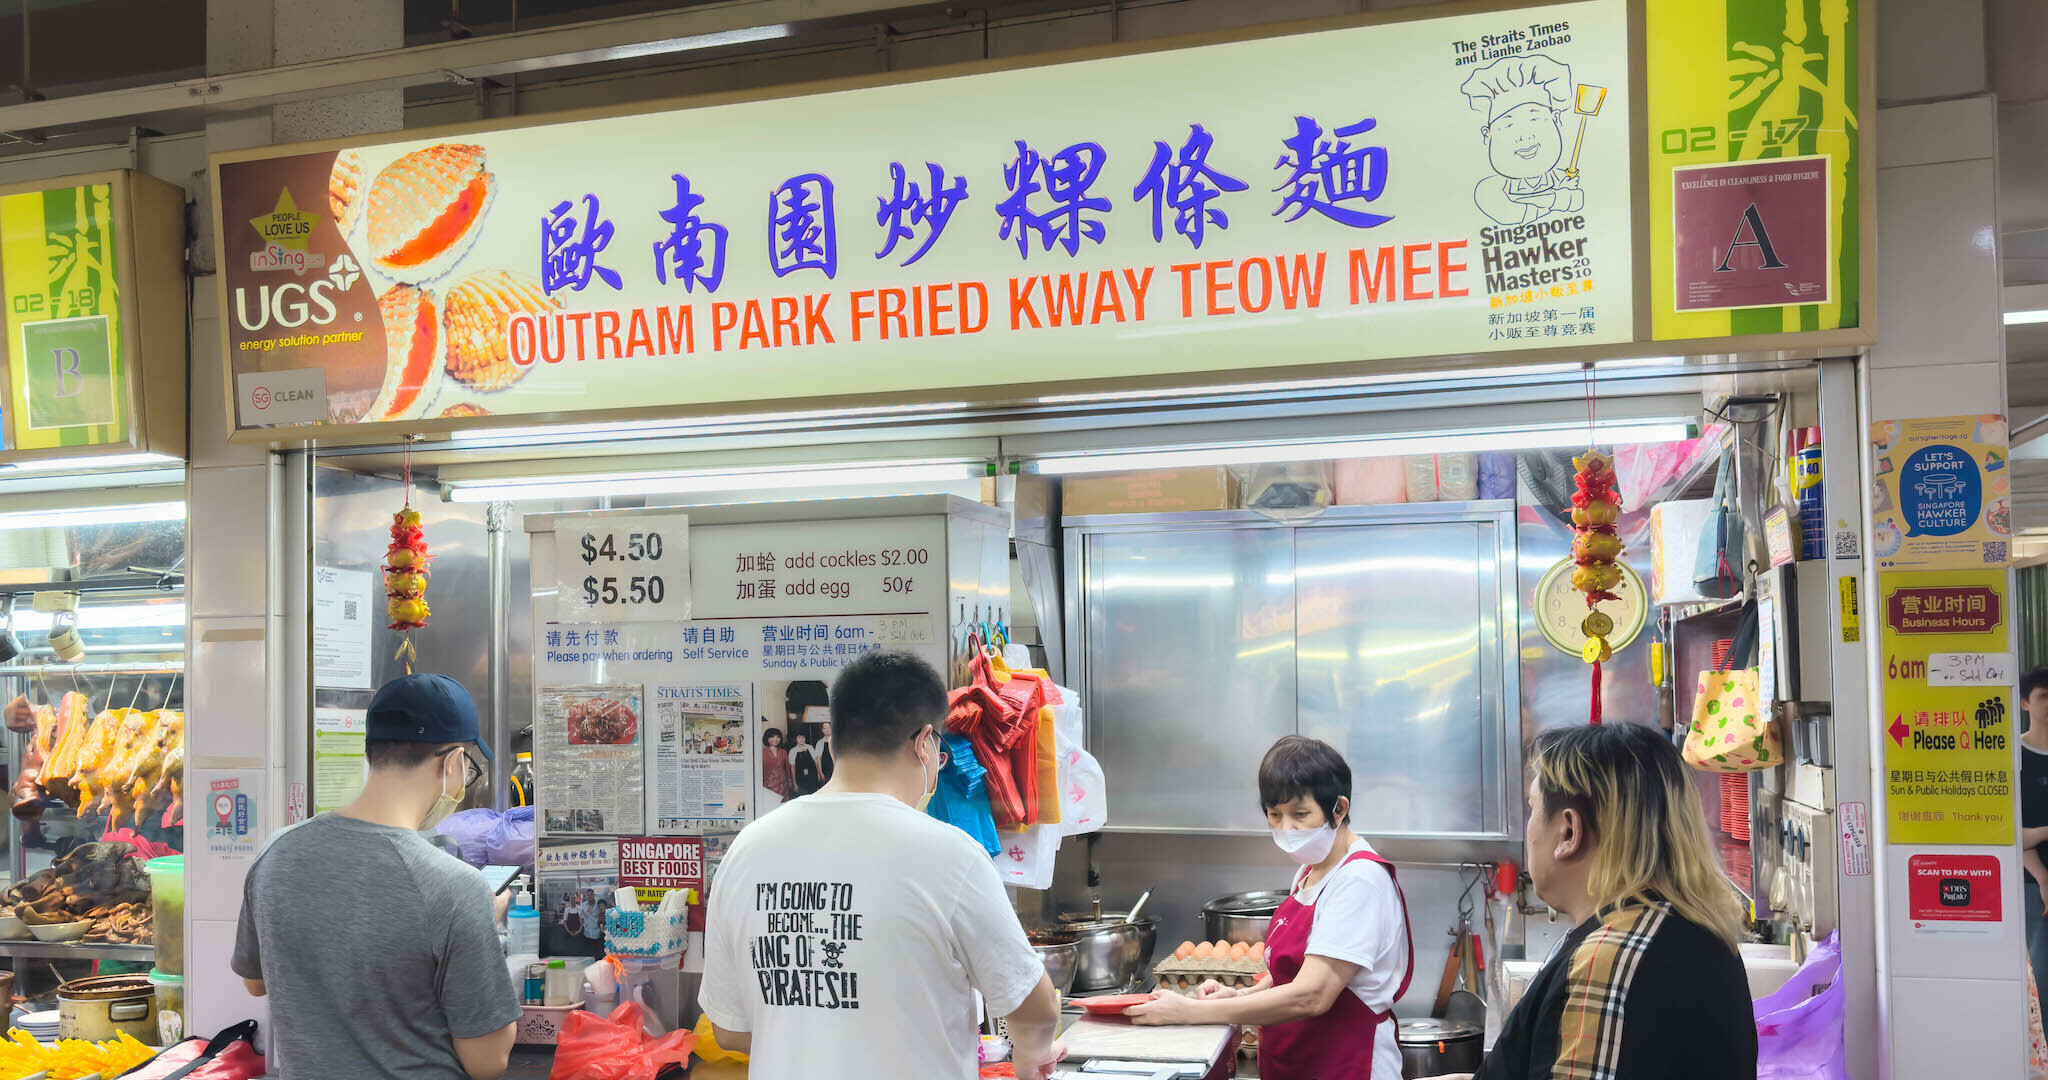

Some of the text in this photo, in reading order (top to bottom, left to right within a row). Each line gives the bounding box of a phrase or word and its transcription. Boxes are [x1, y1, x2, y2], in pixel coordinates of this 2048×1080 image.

[1452, 20, 1570, 55] The Straits Times
[1455, 34, 1572, 66] and Lianhe Zaobao
[1662, 126, 1716, 154] 02
[1761, 116, 1809, 147] 17
[1682, 170, 1820, 190] EXCELLENCE IN CLEANLINESS & FOOD HYGIENE
[272, 213, 302, 222] PEOPLE
[265, 222, 310, 236] LOVE US
[1480, 215, 1586, 248] Singapore
[1713, 202, 1789, 272] A
[1482, 237, 1588, 273] Hawker
[1573, 257, 1590, 269] 20
[1485, 265, 1574, 295] Masters
[1575, 268, 1592, 279] 10
[13, 294, 44, 314] 02
[236, 280, 337, 332] UGS
[509, 238, 1470, 367] OUTRAM PARK FRIED KWAY TEOW MEE
[1488, 306, 1596, 326] 新加坡第一届
[239, 330, 364, 352] energy solution partner
[52, 348, 83, 399] B
[274, 389, 314, 403] CLEAN
[1924, 452, 1954, 462] LET'S
[1914, 461, 1965, 472] SUPPORT
[1917, 501, 1965, 510] SINGAPORE
[1917, 509, 1967, 519] HAWKER
[1918, 518, 1967, 528] CULTURE
[581, 532, 663, 566] $4.50
[736, 547, 929, 573] 加蛤 add cockles $2.00
[583, 574, 665, 608] $5.50
[736, 576, 914, 601] 加蛋 add egg 50¢
[1901, 594, 1986, 615] 营业时间
[1902, 617, 1986, 628] Business Hours
[546, 630, 619, 647] 请先付款
[683, 626, 735, 644] 请自助
[762, 624, 829, 642] 营业时间
[835, 625, 865, 639] 6am
[547, 649, 673, 664] Please pay when ordering
[683, 646, 749, 660] Self Service
[762, 657, 798, 669] Sunday
[800, 659, 808, 668] &
[810, 657, 838, 667] Public
[1888, 654, 1925, 680] 6am
[657, 687, 703, 698] STRAITS
[1914, 711, 1970, 728] 请排队
[1914, 730, 2005, 750] Please Q Here
[1890, 770, 2008, 783] 星期日与公共假日休息
[1890, 785, 2009, 797] Sun & Public Holidays CLOSED
[1952, 812, 2003, 823] Thank you
[622, 843, 700, 860] SINGAPORE
[624, 861, 698, 876] BEST FOODS
[1970, 869, 1992, 877] WITH
[645, 879, 678, 887] ENJOY
[1950, 885, 1967, 893] DBS
[756, 882, 853, 911] I'M GOING TO
[768, 912, 863, 941] BECOME... THE
[749, 934, 815, 969] KING OF
[757, 969, 860, 1009] PIRATES!!
